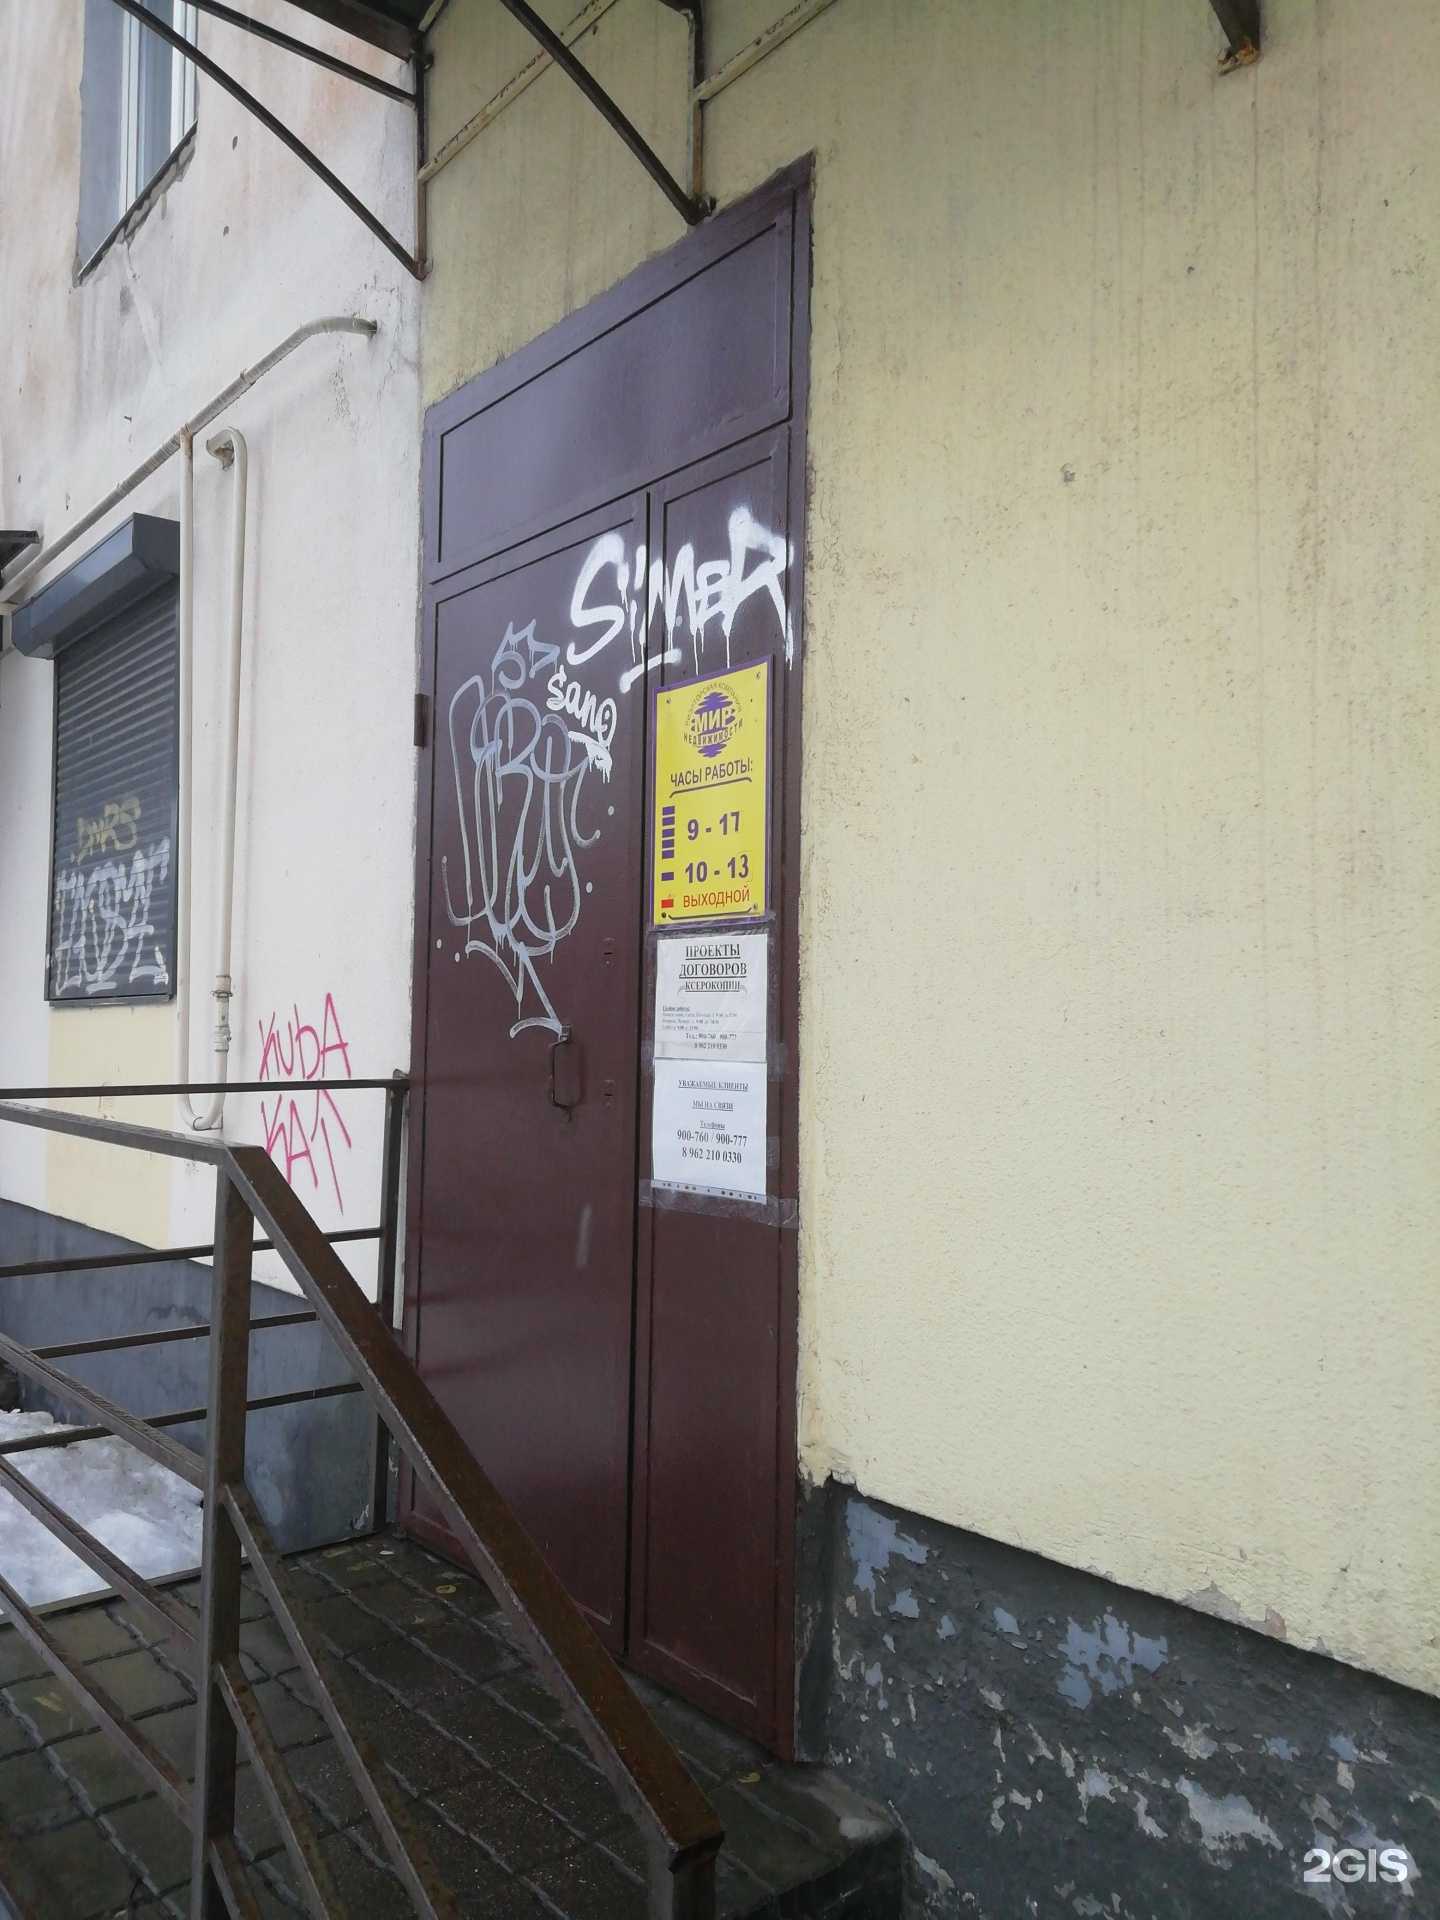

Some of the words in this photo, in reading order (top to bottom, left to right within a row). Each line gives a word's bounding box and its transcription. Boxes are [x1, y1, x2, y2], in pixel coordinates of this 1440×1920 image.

[693, 706, 736, 733] МИР
[683, 718, 744, 746] НЕДВИЖИМОСТИ
[670, 768, 702, 787] ЧАСЫ
[705, 757, 753, 781] РАБОТЫ:
[688, 819, 699, 840] 9
[720, 811, 740, 835] 17
[685, 862, 708, 884] 10
[728, 854, 749, 879] 13
[683, 885, 751, 908] ВЫХОДНОЙ
[685, 944, 741, 960] ПРОЕКТЫ
[679, 963, 748, 979] ДОГОВОРОВ
[685, 981, 741, 992] КСЕРОКОПИИ
[677, 1129, 709, 1143] 900-760
[716, 1133, 748, 1147] 900-777
[682, 1147, 688, 1158] 8
[689, 1148, 704, 1160] 962
[705, 1149, 720, 1161] 210
[722, 1151, 743, 1164] 0330
